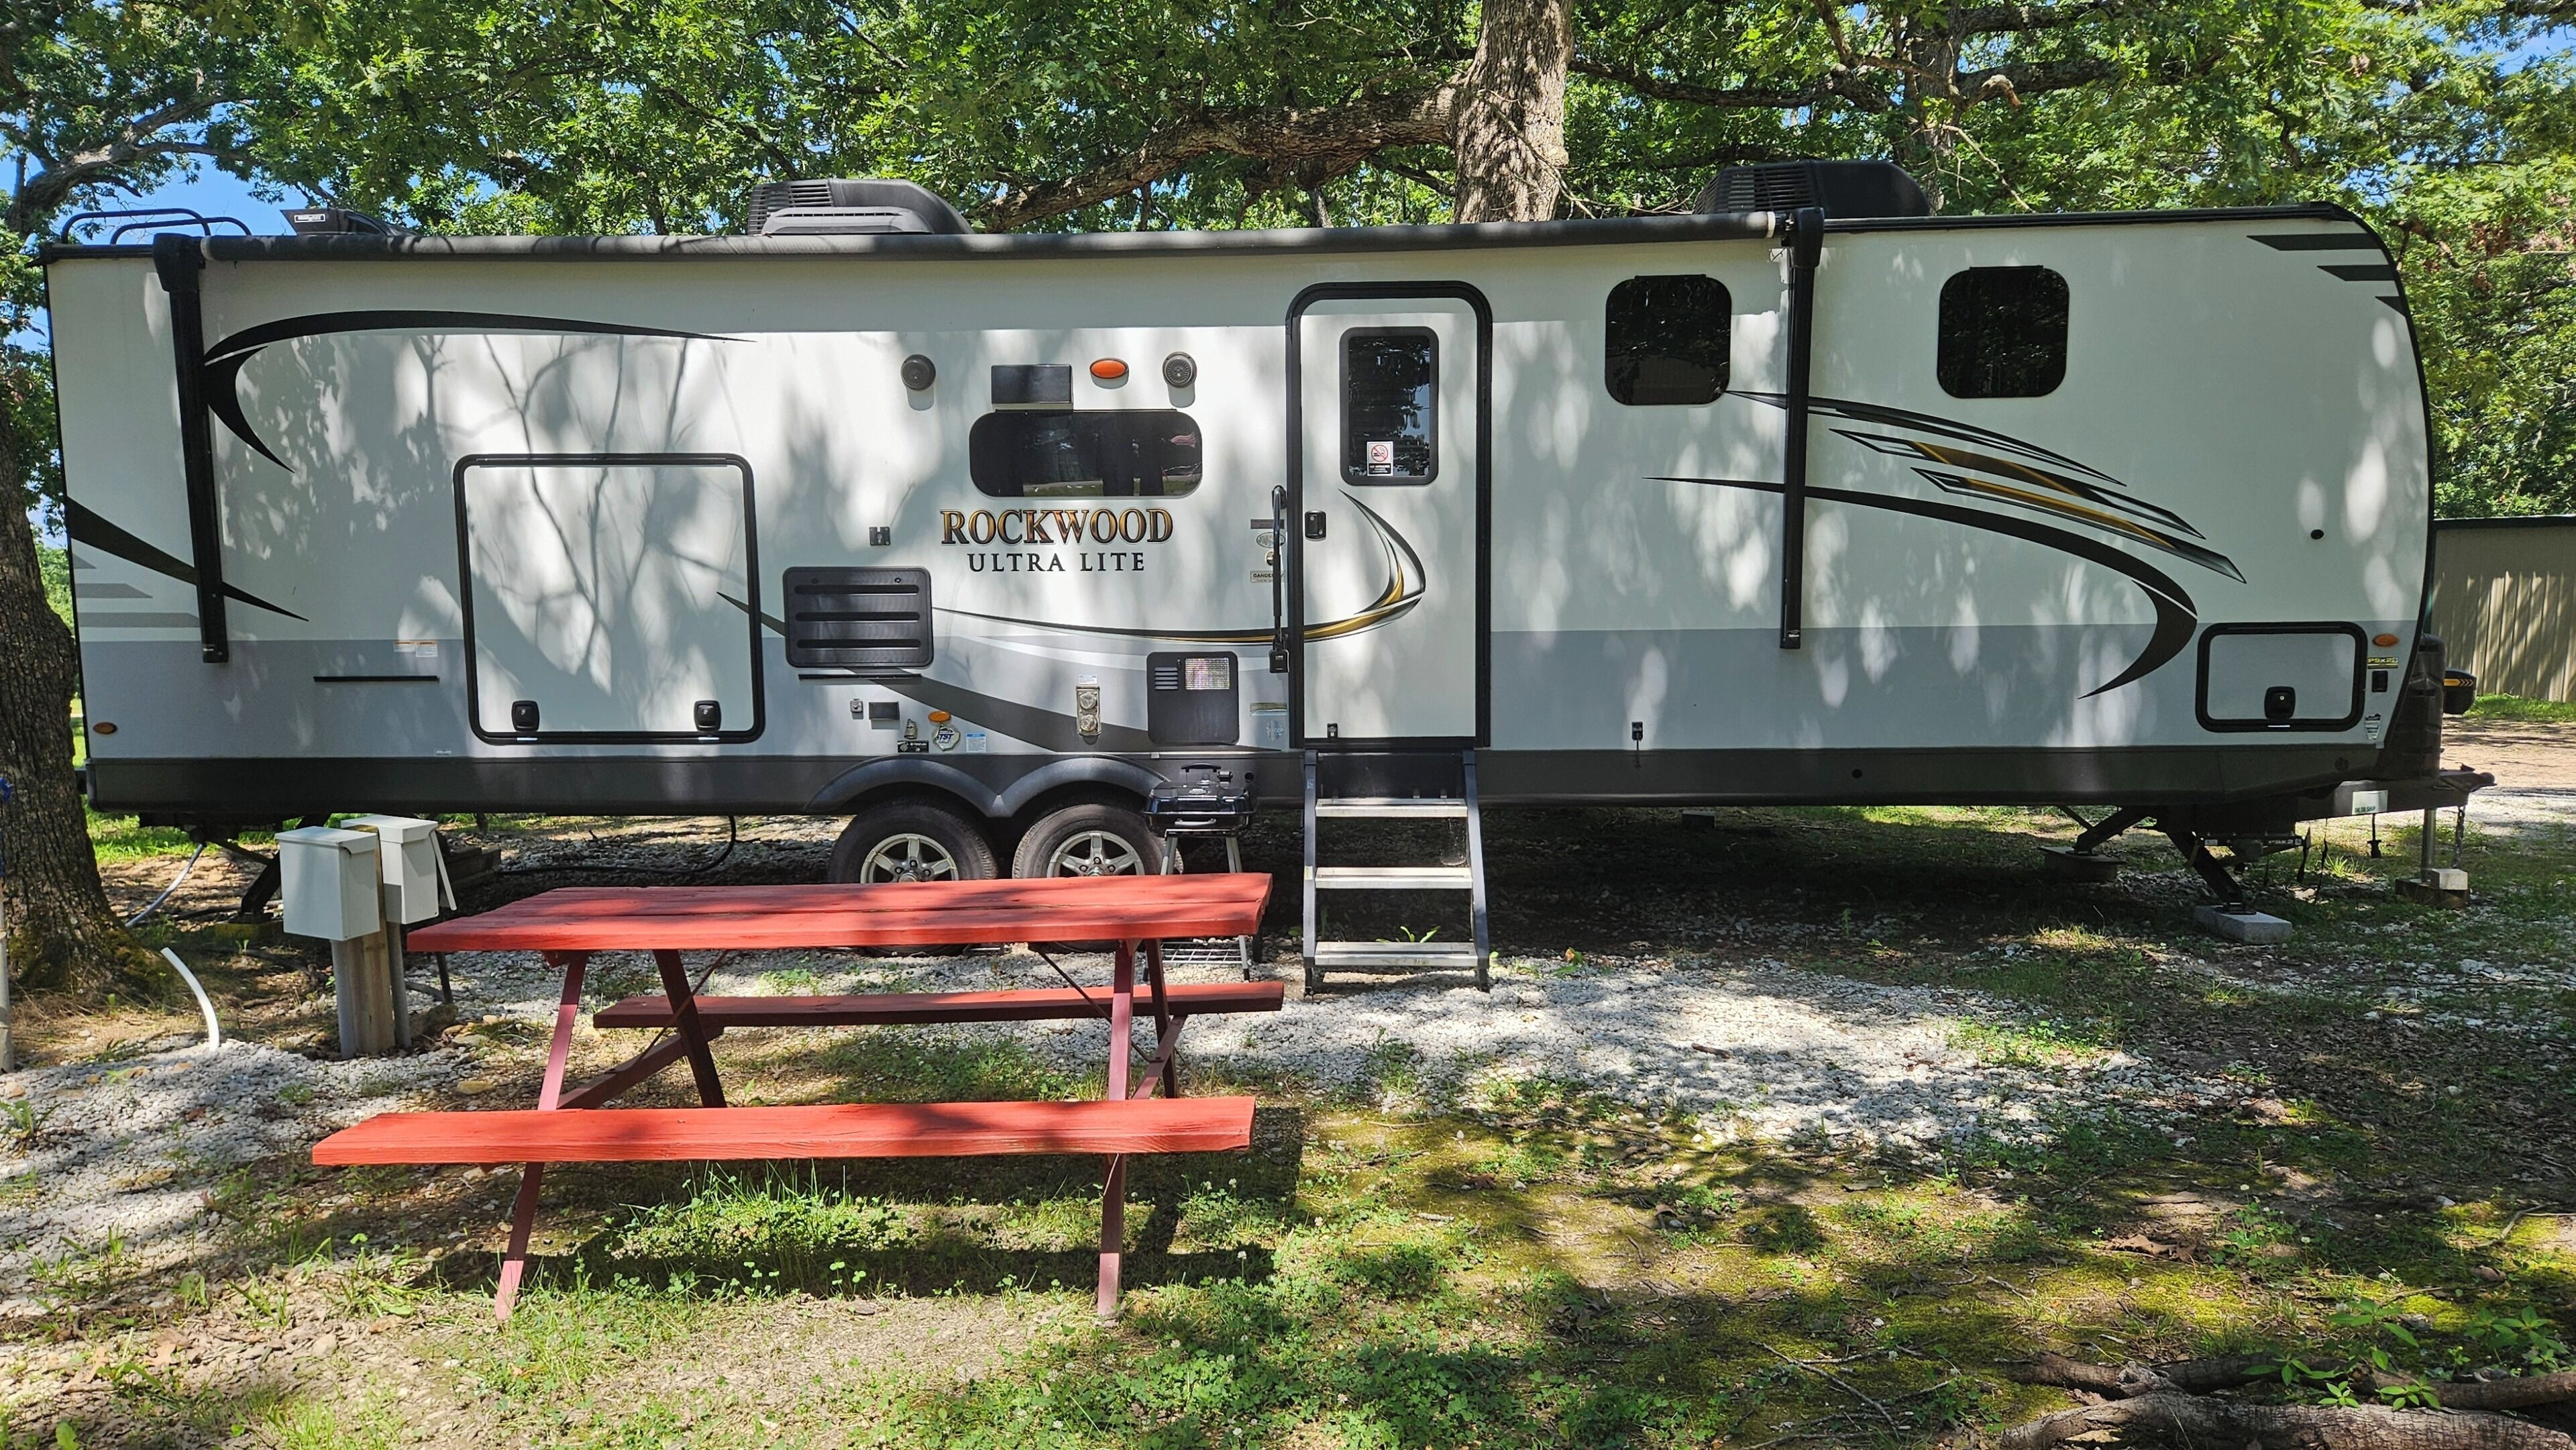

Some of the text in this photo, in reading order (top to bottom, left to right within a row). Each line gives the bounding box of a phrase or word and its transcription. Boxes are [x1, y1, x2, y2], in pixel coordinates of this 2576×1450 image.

[940, 508, 1173, 544] ROCKWOOD
[967, 552, 1144, 572] ULTRA LITE
